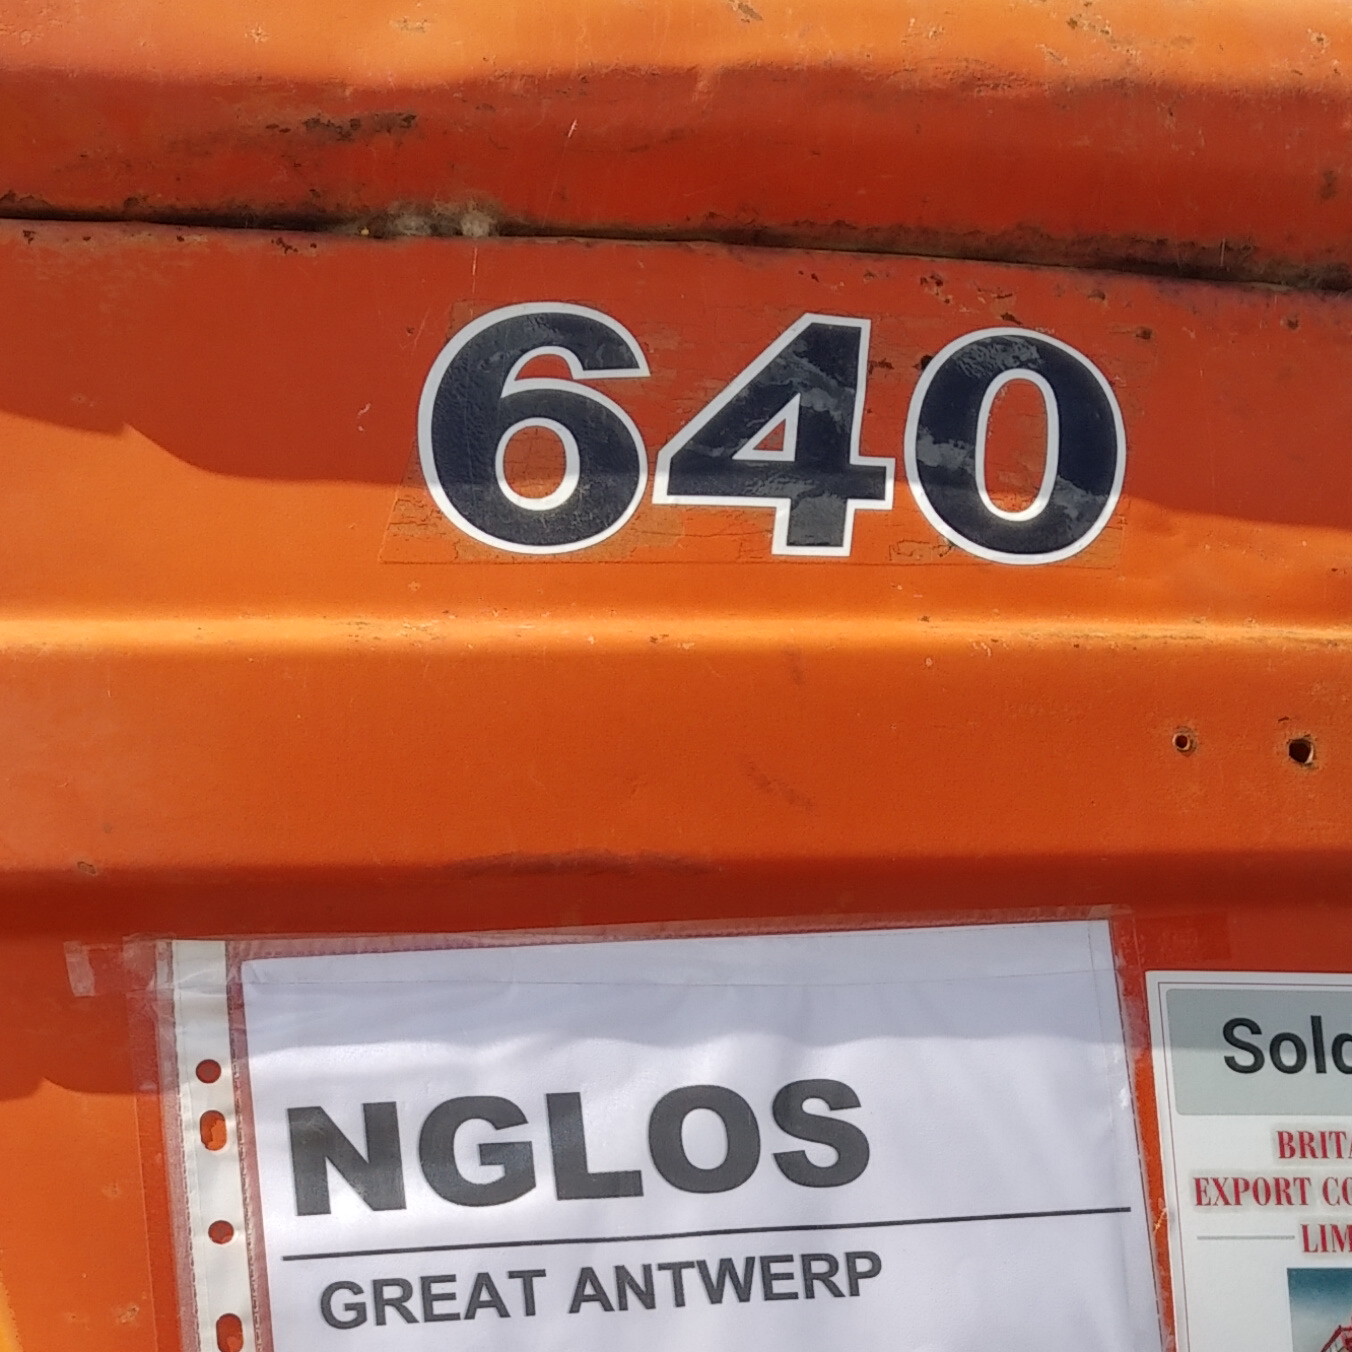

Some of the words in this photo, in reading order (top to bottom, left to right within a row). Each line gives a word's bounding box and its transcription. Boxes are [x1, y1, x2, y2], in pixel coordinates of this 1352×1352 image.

[417, 301, 1127, 565] 640
[286, 1079, 870, 1216] NGLOS
[1195, 1178, 1311, 1206] EXPORT
[320, 1269, 546, 1330] GREAT
[568, 1251, 881, 1314] ANTWERP
